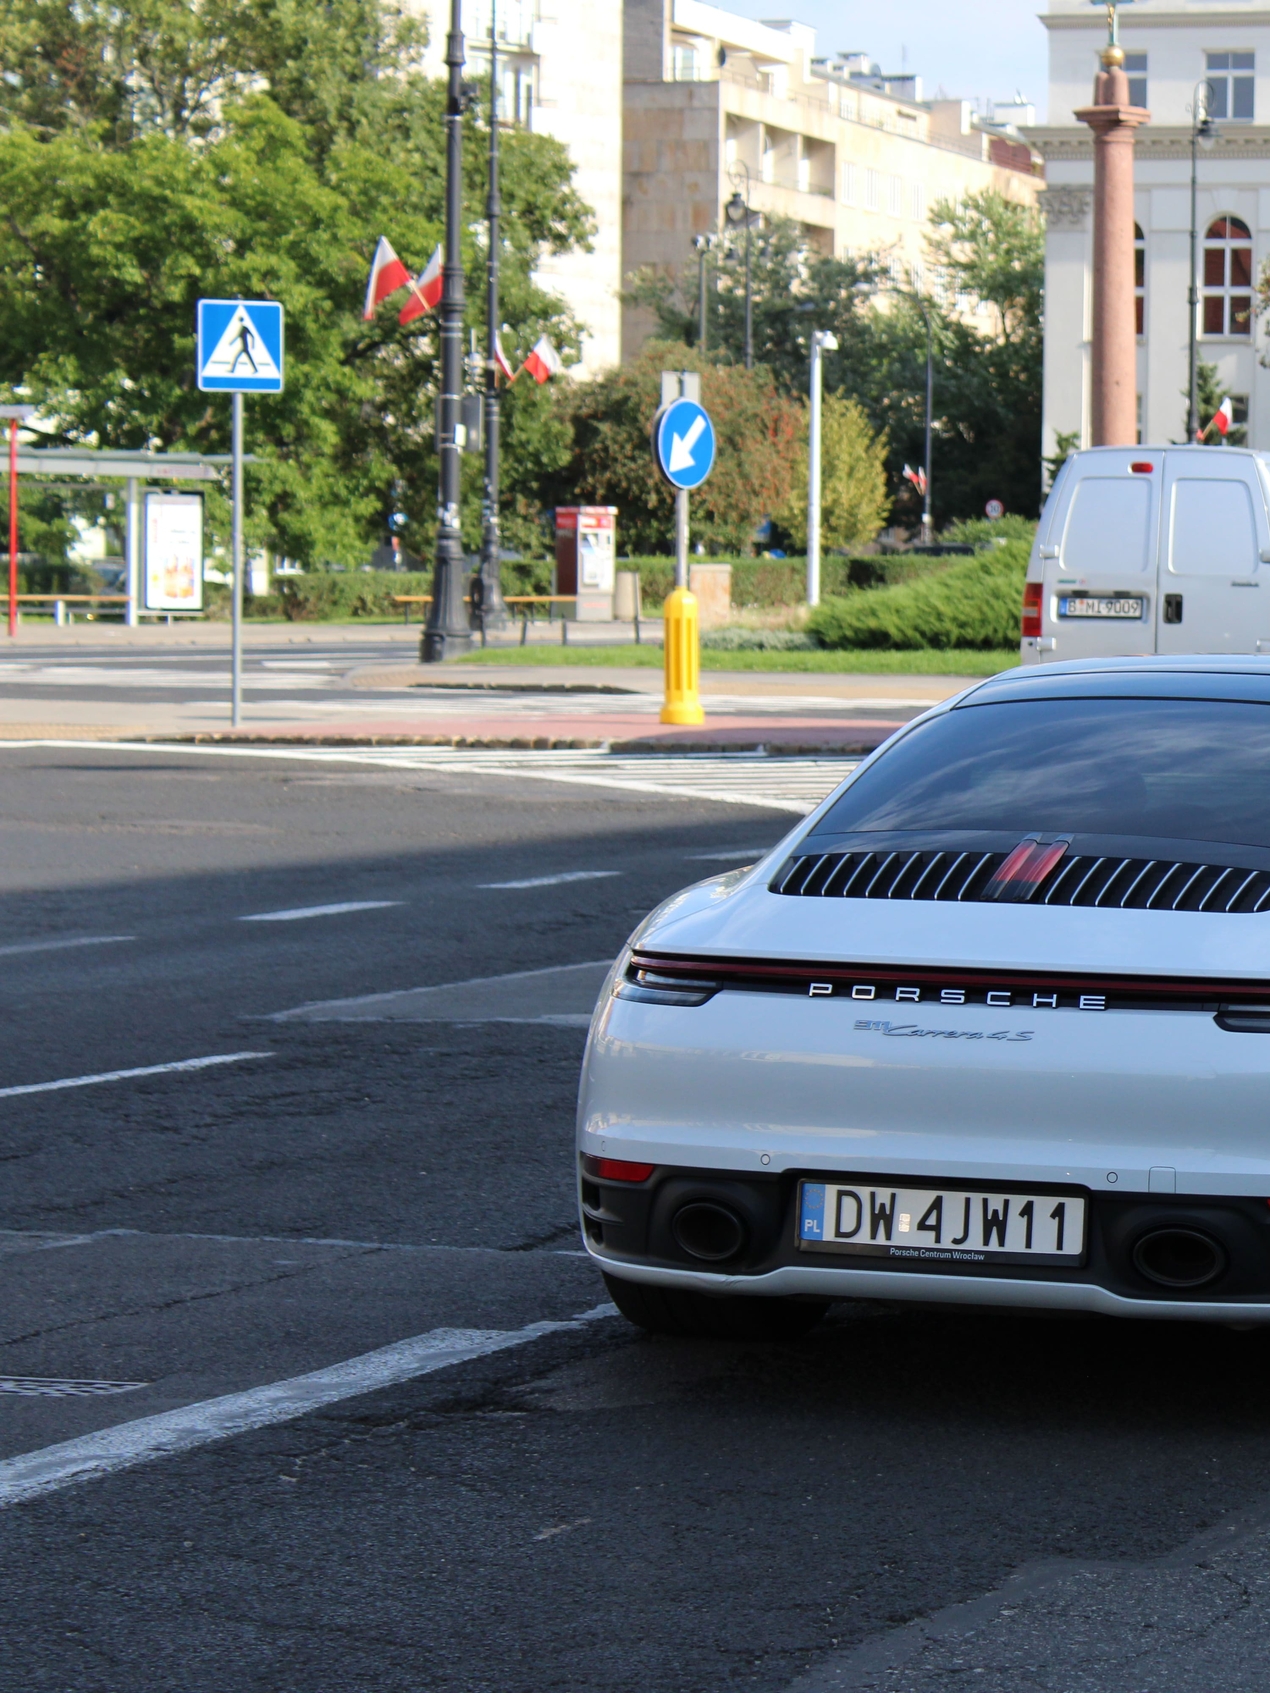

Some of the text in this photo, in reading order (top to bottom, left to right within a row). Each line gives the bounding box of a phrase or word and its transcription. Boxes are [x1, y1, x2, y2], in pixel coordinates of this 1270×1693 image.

[808, 983, 1107, 1010] PORSCHE
[853, 1019, 891, 1031] 911
[882, 1024, 984, 1041] Carrera
[804, 1219, 821, 1233] PL
[833, 1189, 1066, 1251] DW 4JW11
[889, 1247, 919, 1258] Porsche
[920, 1249, 952, 1260] Centrum
